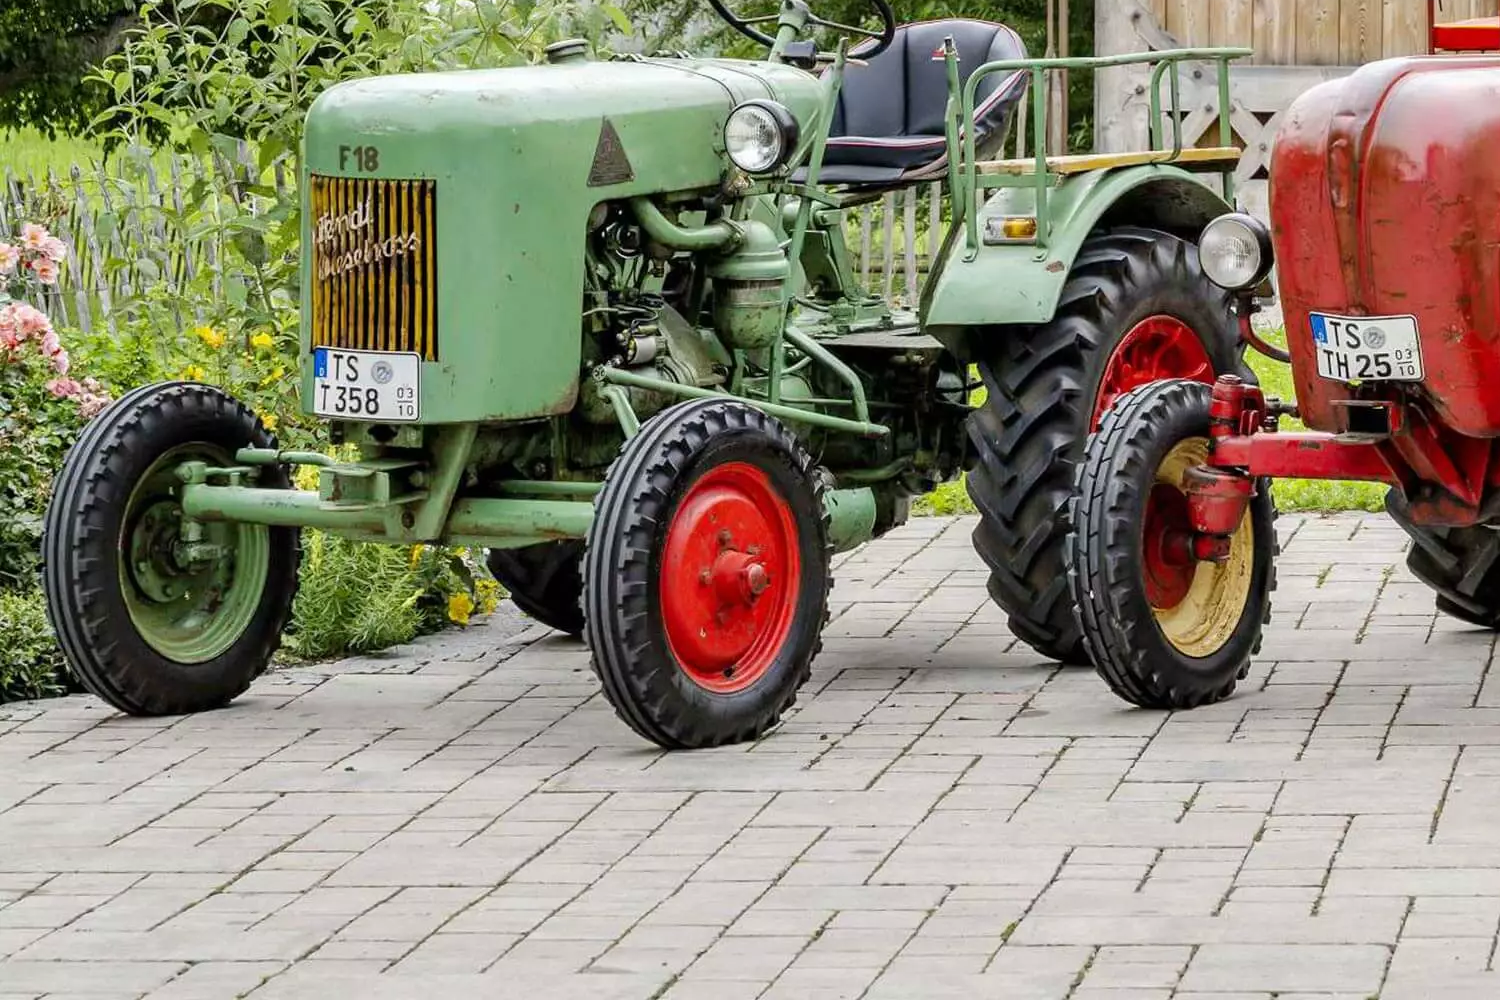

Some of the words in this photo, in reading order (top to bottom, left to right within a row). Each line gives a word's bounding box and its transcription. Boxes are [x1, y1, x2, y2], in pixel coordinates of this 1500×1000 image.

[339, 145, 379, 172] F18
[1329, 320, 1361, 349] TS
[333, 353, 359, 382] TS
[1323, 349, 1350, 379] TH
[1355, 353, 1392, 378] 25
[321, 383, 331, 411] T
[335, 385, 379, 415] 358
